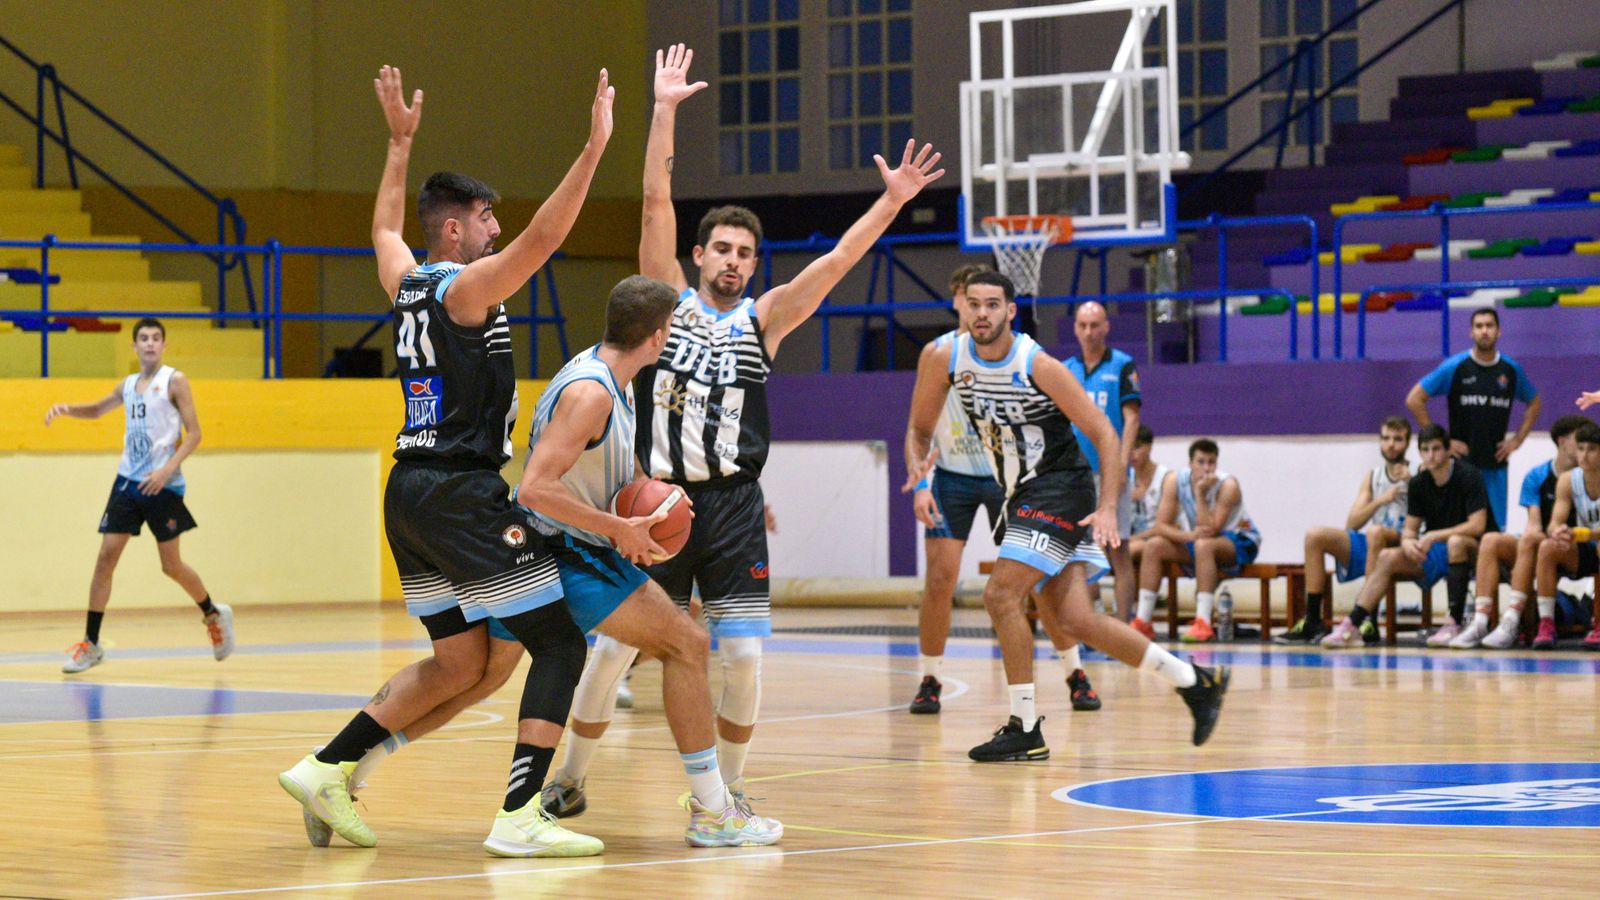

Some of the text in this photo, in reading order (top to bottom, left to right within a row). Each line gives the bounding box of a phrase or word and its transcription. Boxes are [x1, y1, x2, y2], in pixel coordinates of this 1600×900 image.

[396, 309, 437, 369] 41
[131, 403, 146, 419] 13
[1030, 529, 1050, 552] 10
[516, 552, 535, 566] vive
